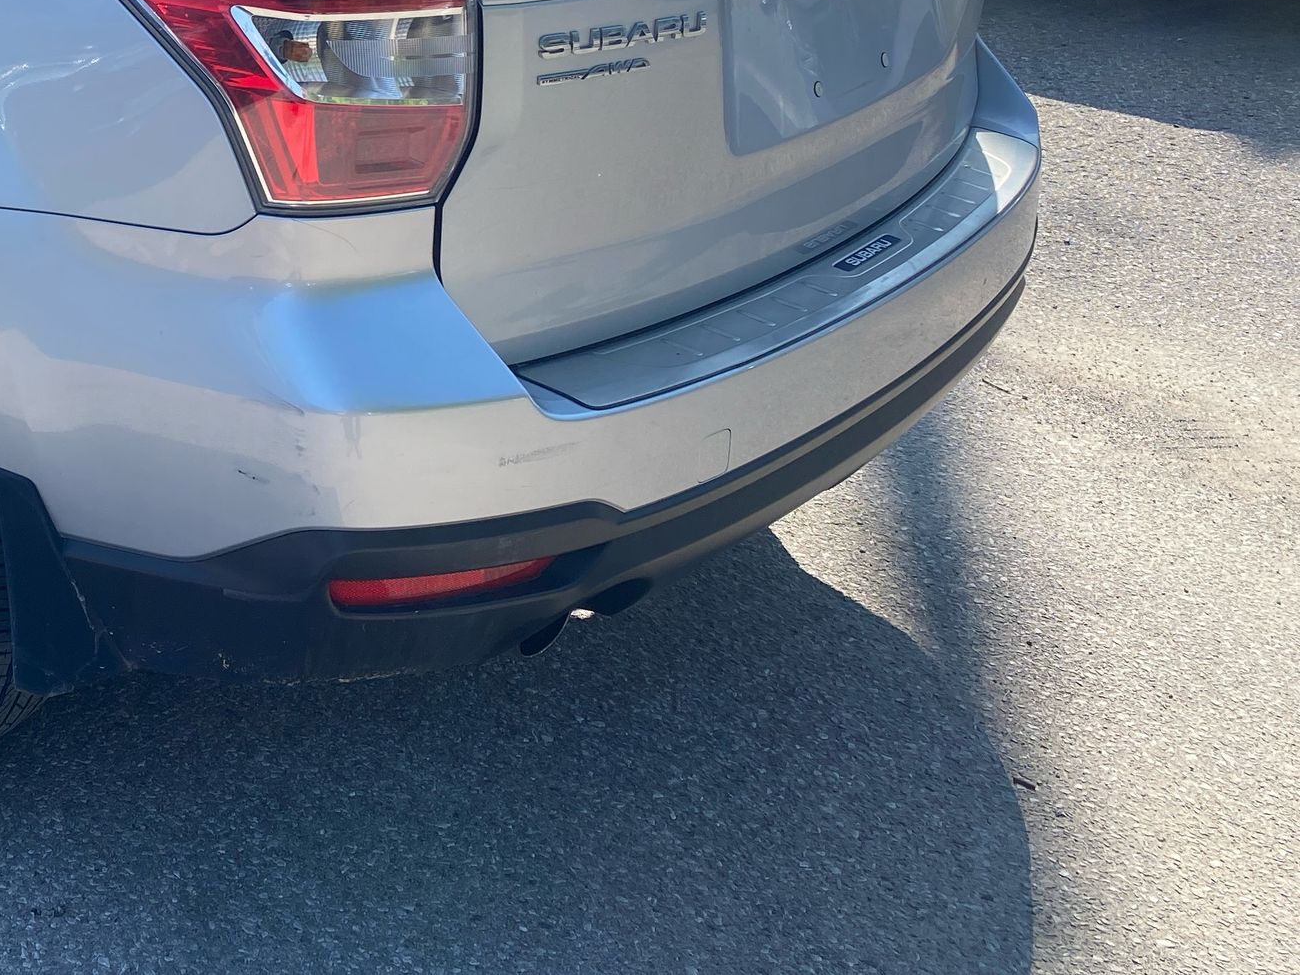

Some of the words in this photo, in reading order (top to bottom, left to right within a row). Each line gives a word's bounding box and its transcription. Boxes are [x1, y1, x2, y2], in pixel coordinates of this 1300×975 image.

[538, 10, 707, 60] SUBARU
[581, 57, 651, 80] AWD
[844, 238, 892, 266] SUBARU
